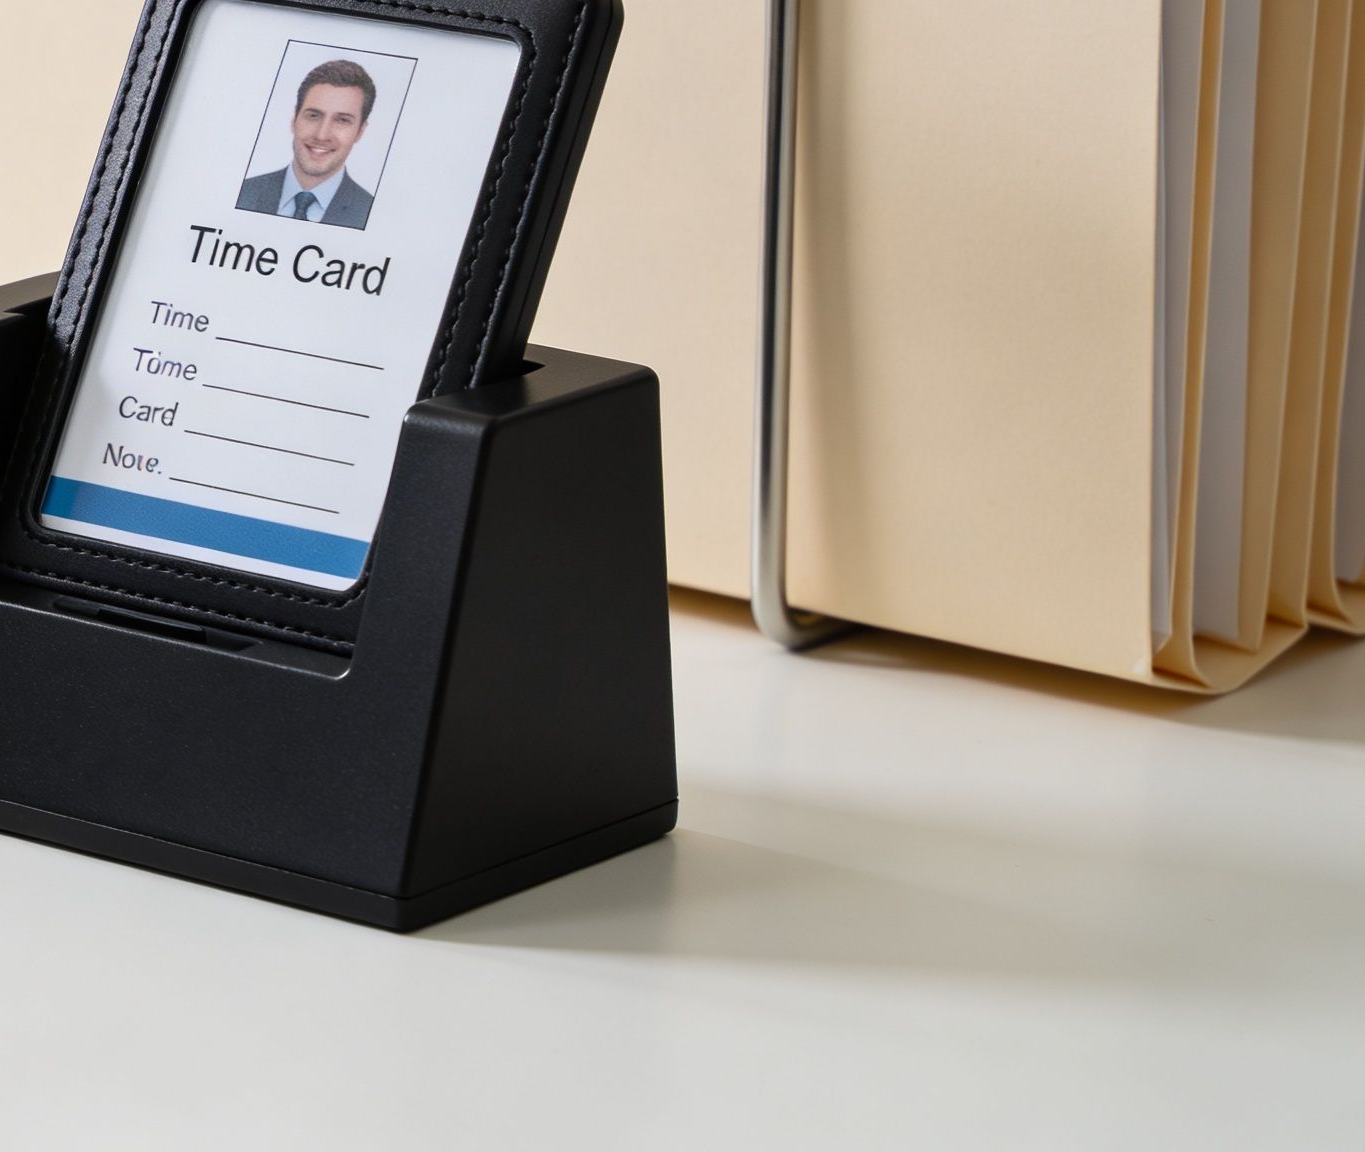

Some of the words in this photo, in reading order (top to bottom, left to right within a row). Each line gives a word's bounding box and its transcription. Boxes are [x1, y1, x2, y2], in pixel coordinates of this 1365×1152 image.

[190, 224, 278, 276] Time
[292, 244, 391, 296] Card
[151, 300, 209, 333] Time
[118, 395, 179, 427] Card
